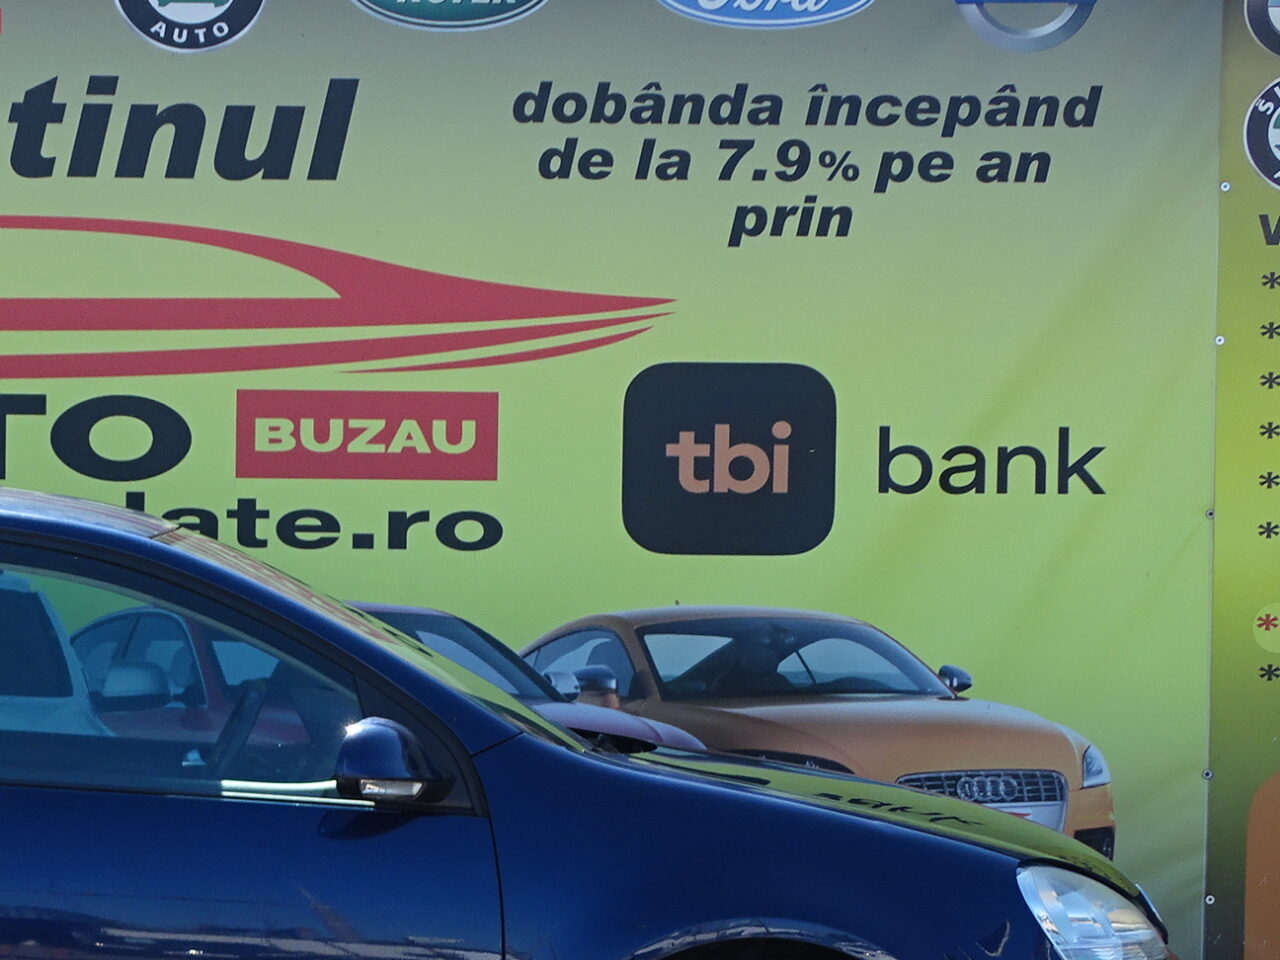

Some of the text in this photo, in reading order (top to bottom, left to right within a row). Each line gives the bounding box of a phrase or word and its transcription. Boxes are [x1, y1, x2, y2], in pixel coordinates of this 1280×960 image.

[150, 21, 229, 44] AUTO
[512, 81, 1104, 137] dobânda începând
[538, 137, 614, 181] de
[634, 138, 692, 182] la
[873, 150, 955, 194] pe
[975, 151, 1052, 184] an
[727, 195, 853, 248] prin
[254, 417, 477, 455] BUZAU
[665, 420, 1106, 495] tbi bank
[125, 491, 503, 552] ate.ro
